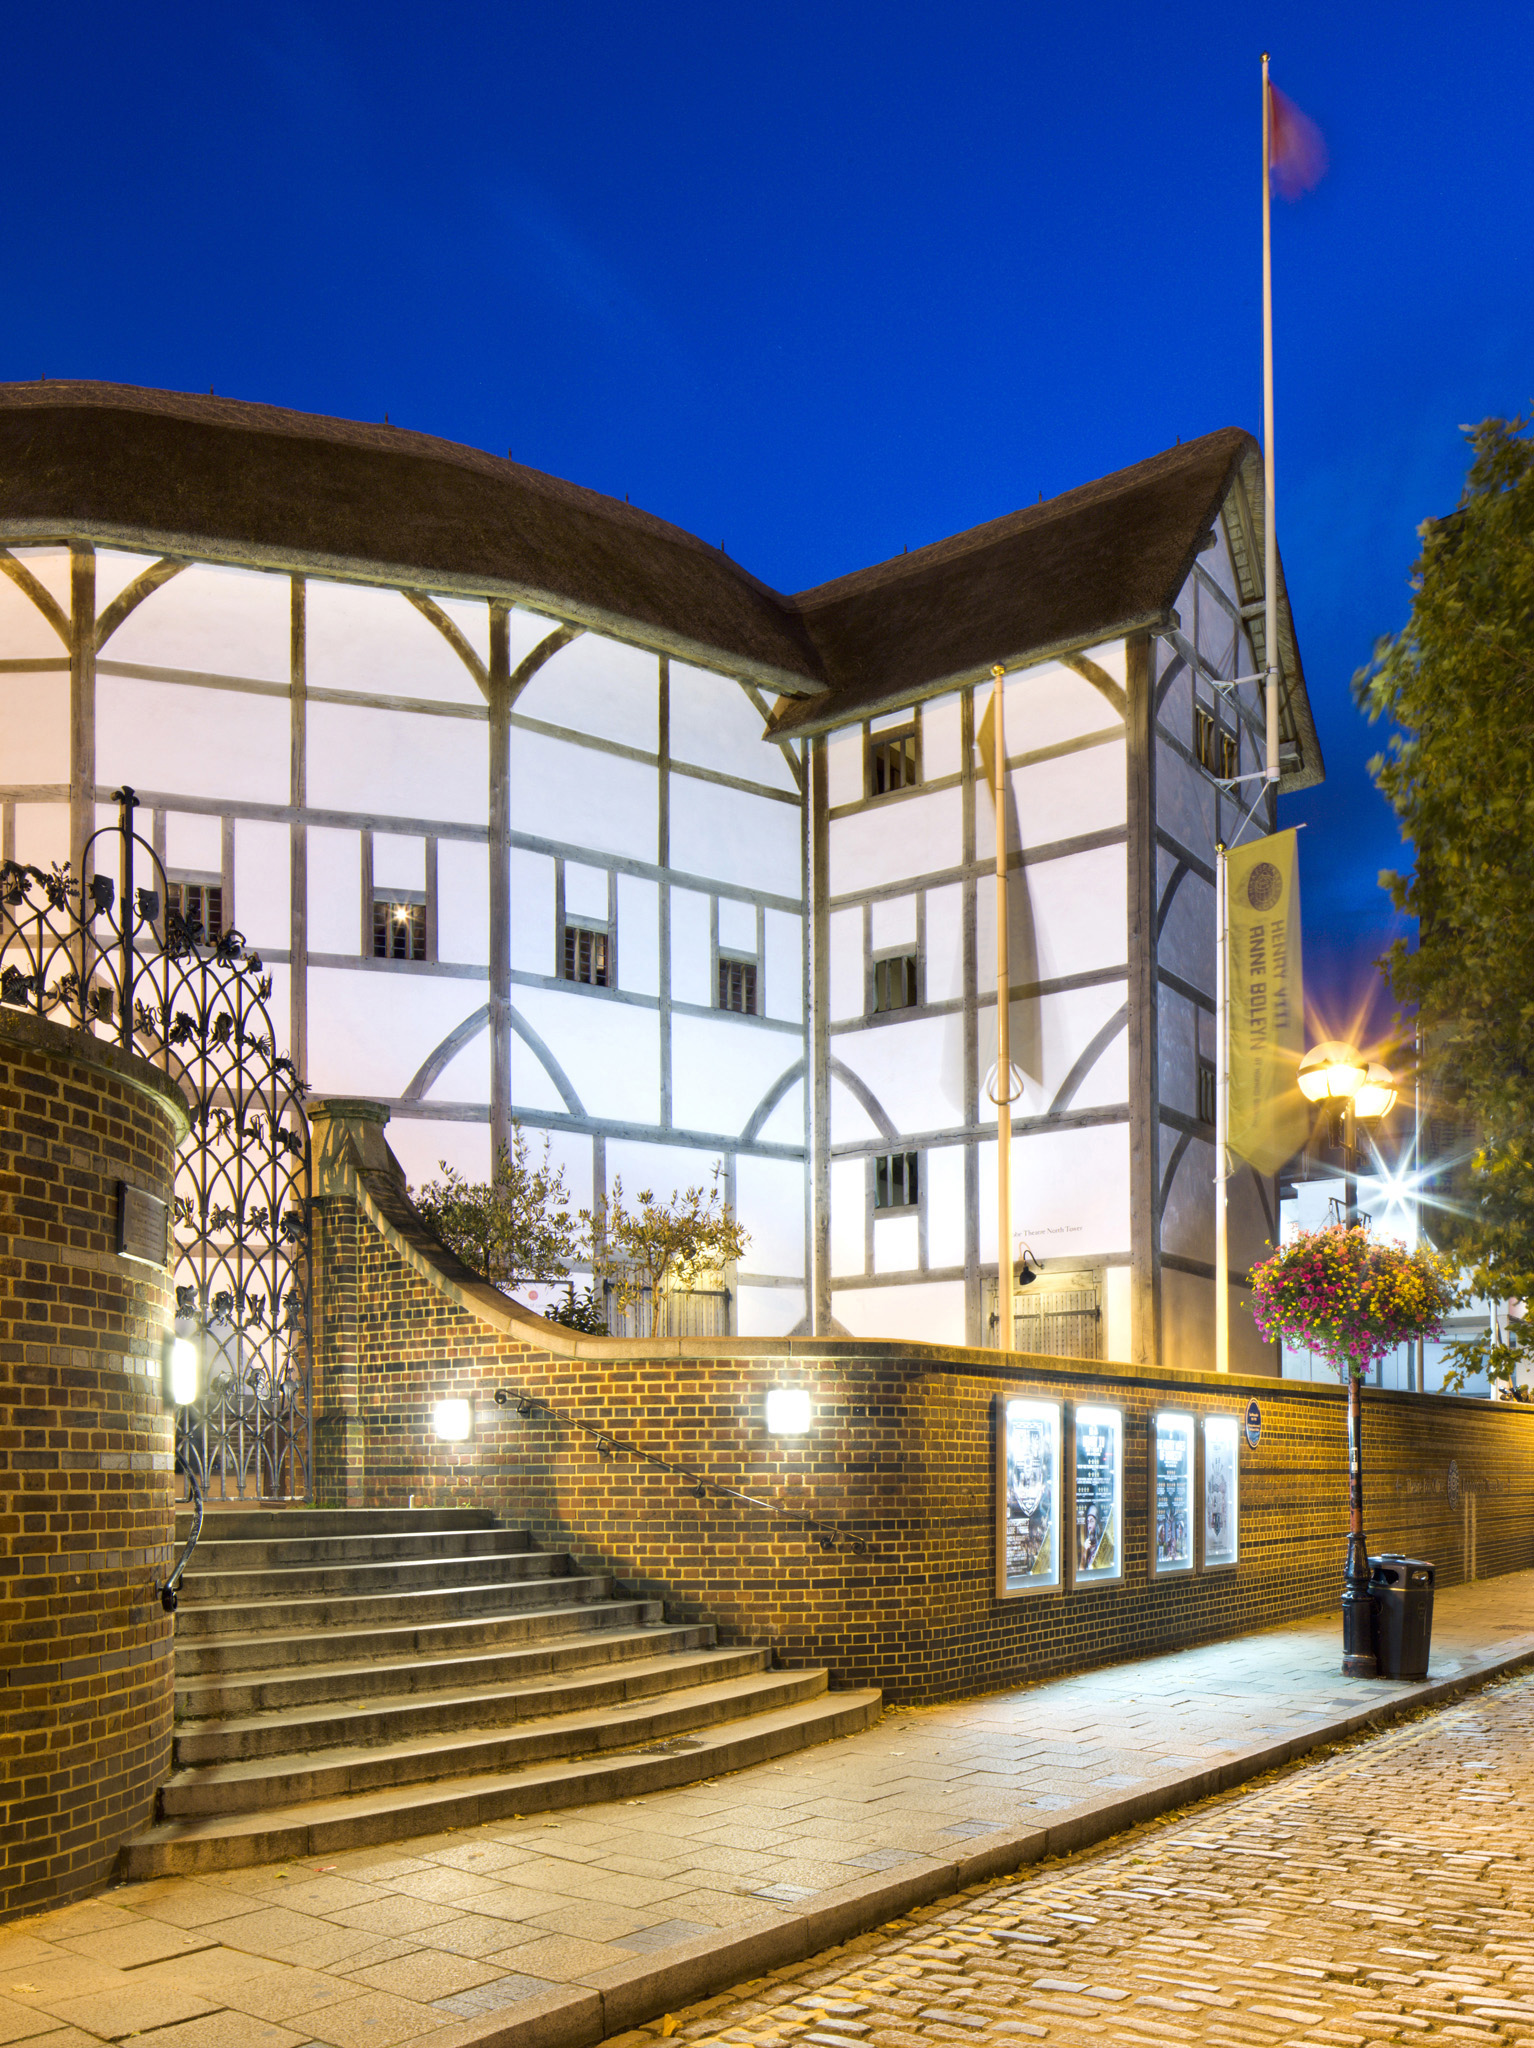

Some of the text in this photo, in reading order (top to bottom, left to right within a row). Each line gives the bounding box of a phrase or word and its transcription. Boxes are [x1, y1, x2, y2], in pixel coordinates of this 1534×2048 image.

[1249, 924, 1267, 977] ANNE
[1271, 919, 1290, 1029] HENRY VIII
[1250, 981, 1268, 1051] BOLEYN
[1065, 1225, 1083, 1233] Tower
